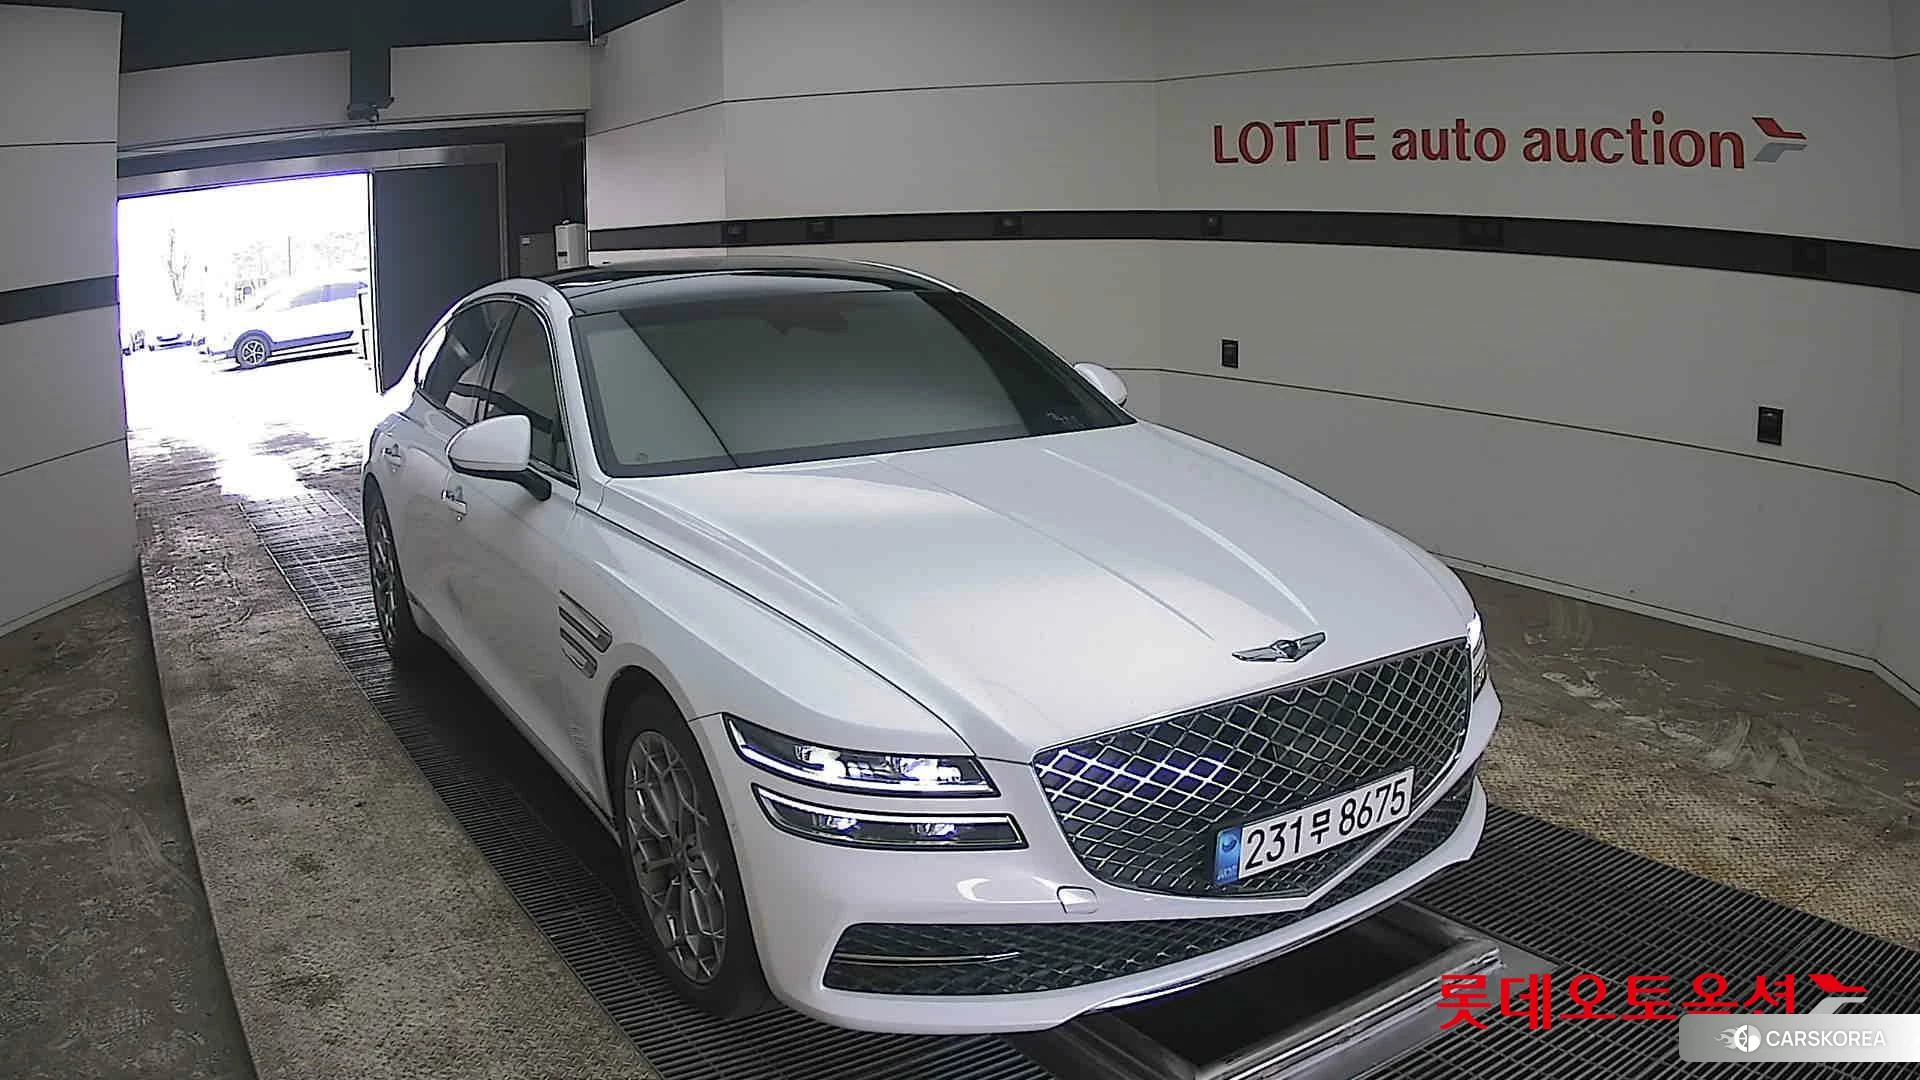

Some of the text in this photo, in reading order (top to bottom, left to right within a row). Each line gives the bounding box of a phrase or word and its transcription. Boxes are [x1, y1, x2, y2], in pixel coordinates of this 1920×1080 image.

[1213, 111, 1745, 169] LOTTE auto auction
